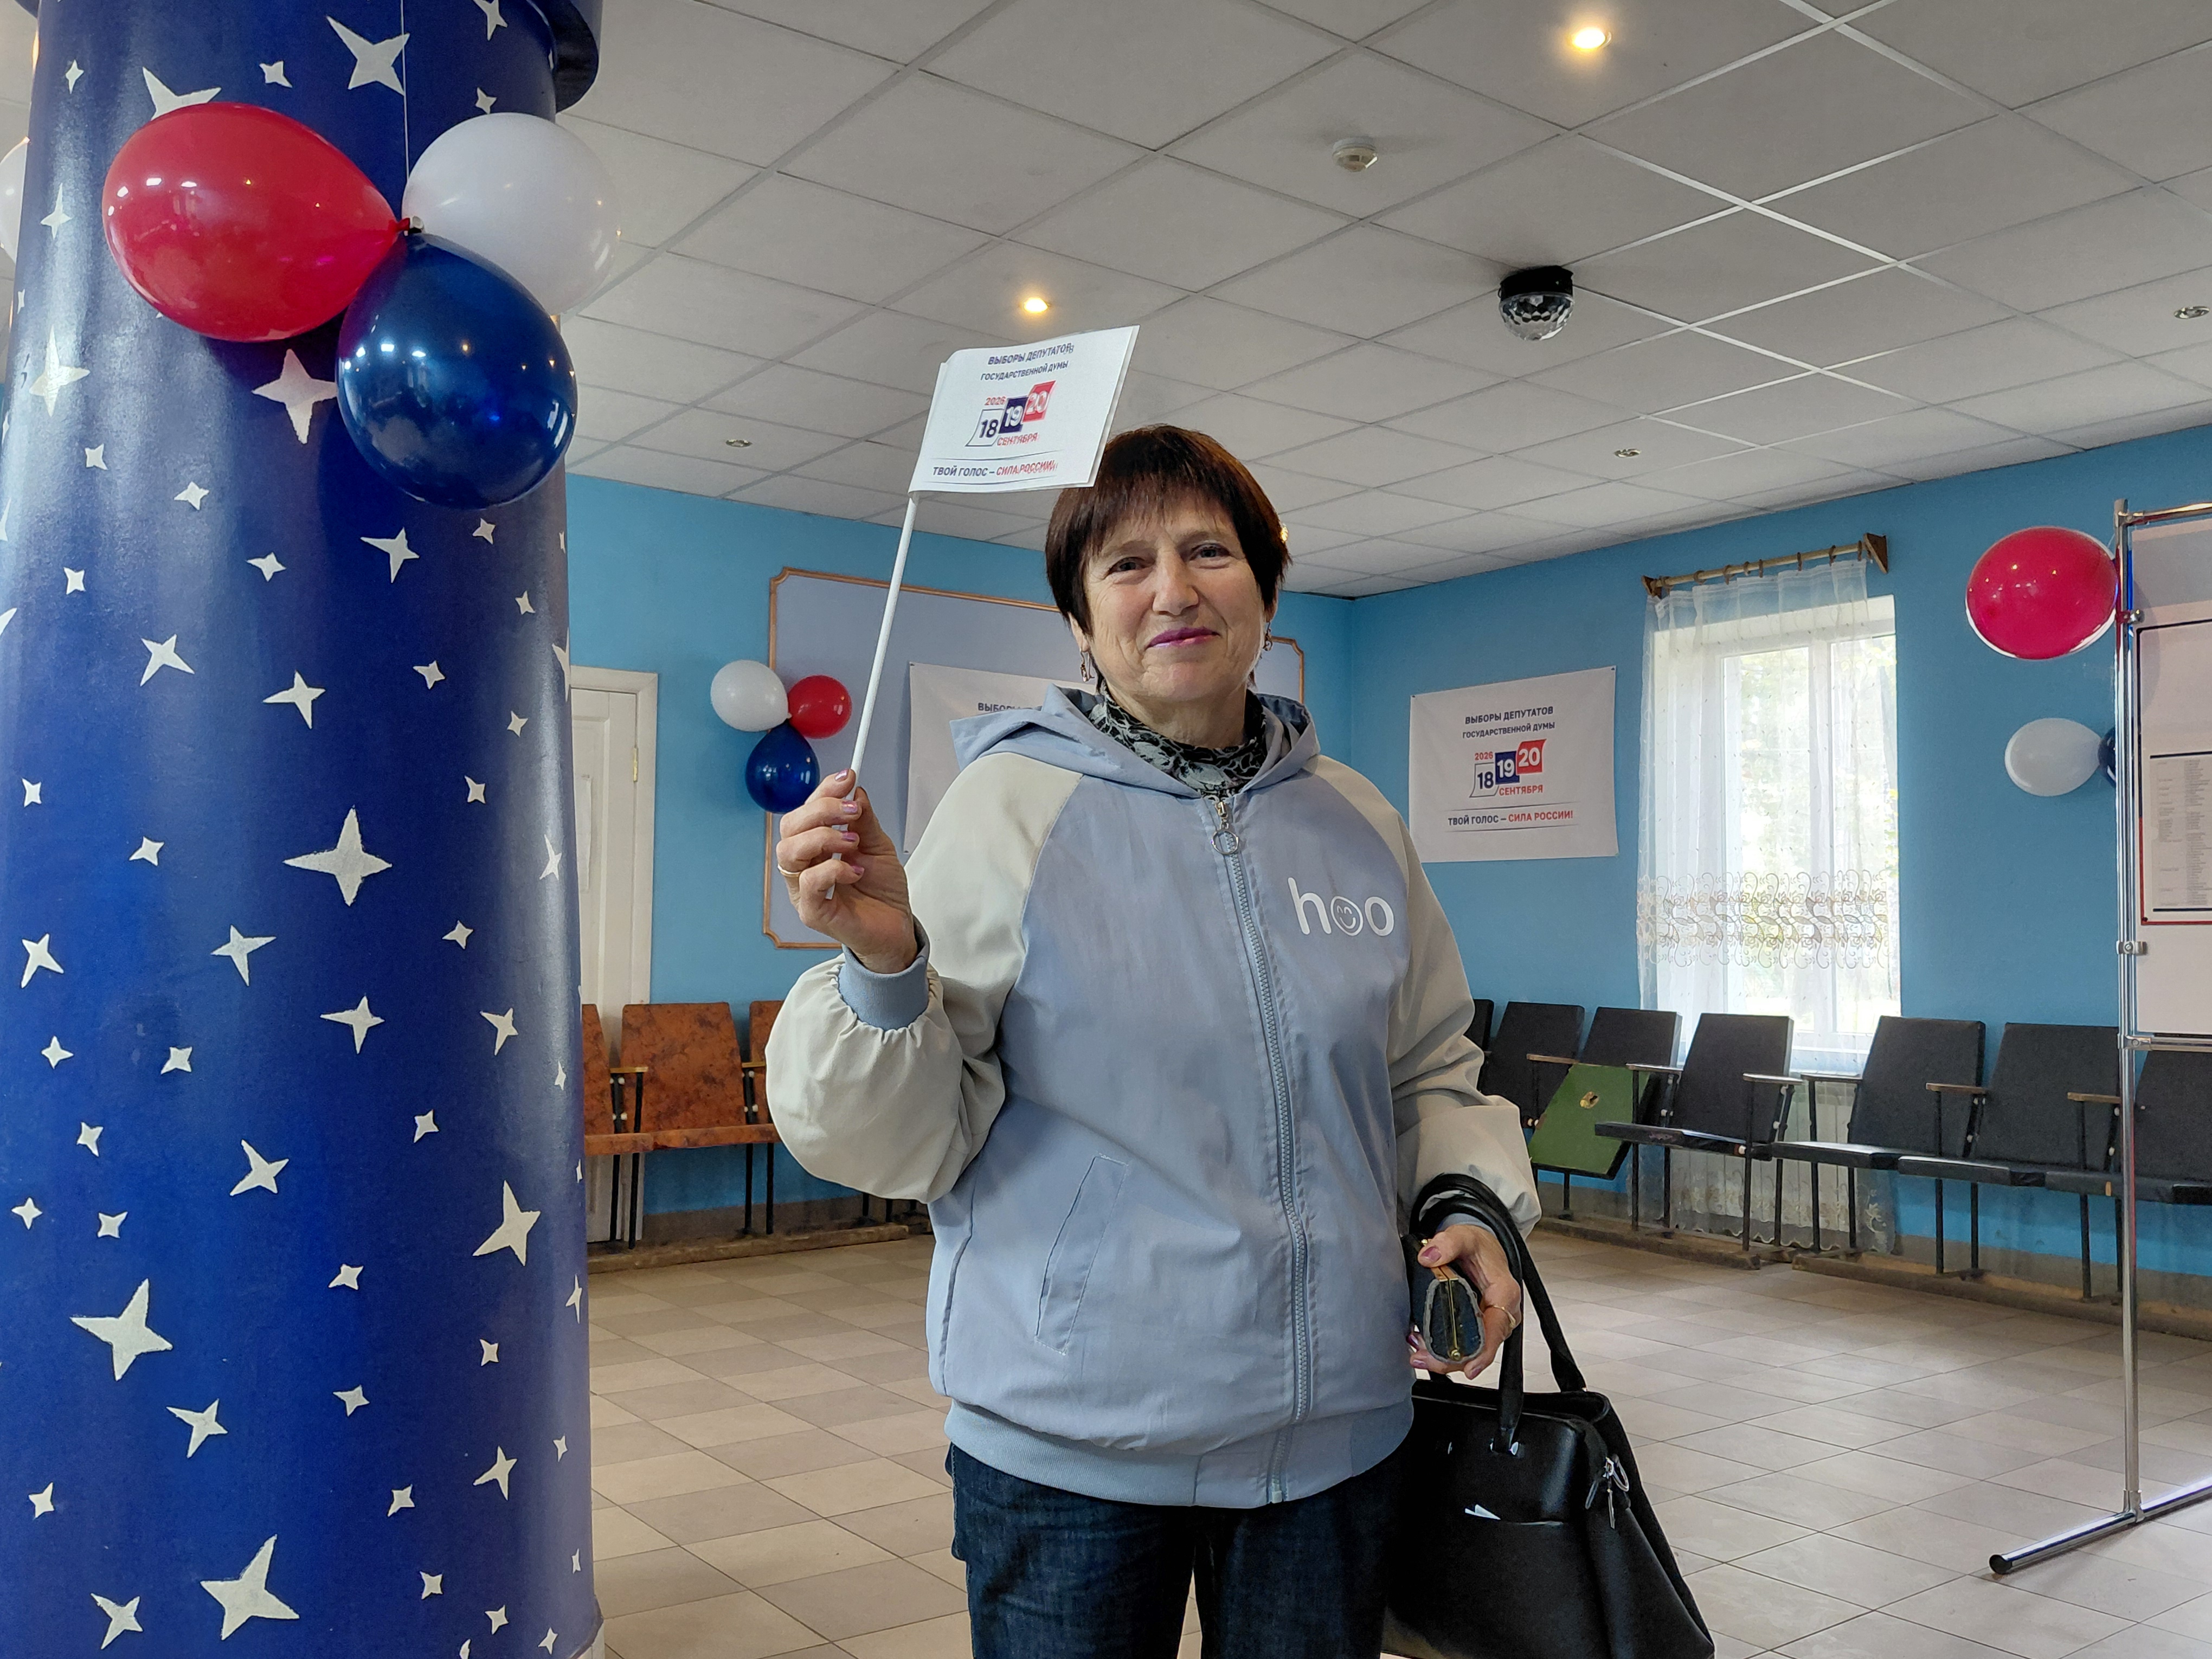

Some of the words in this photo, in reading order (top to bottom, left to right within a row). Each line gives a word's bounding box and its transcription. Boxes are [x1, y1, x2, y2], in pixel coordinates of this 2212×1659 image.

[988, 353, 1026, 365] ВЫБОРЫ
[1025, 343, 1073, 362] ДЕПУТАТОВ
[980, 363, 1049, 381] ГОСУДАРСТВЕННОЙ
[1047, 361, 1069, 373] ДУМЫ
[985, 396, 1006, 406] 2026
[979, 419, 999, 438] 18
[1005, 406, 1024, 427] 19
[1026, 391, 1049, 415] 20
[997, 432, 1038, 446] СЕНТЯБРЯ
[933, 465, 957, 476] ТВОЙ
[958, 467, 988, 477] ГОЛОС
[996, 465, 1019, 476] СИЛА
[1019, 460, 1057, 474] РОССИИ!
[1465, 713, 1501, 724] ВЫБОРЫ
[1503, 706, 1553, 722] ДЕПУТАТОВ
[1463, 723, 1531, 738] ГОСУДАРСТВЕННОЙ
[1533, 722, 1555, 732] ДУМЫ
[1475, 751, 1493, 760] 2026
[1477, 771, 1494, 789] 18
[1497, 759, 1515, 778] 19
[1518, 747, 1540, 767] 20
[1499, 785, 1543, 796] СЕНТЯБРЯ
[1448, 814, 1469, 825] ТВОЙ
[1471, 815, 1499, 824] ГОЛОС
[1508, 813, 1532, 822] СИЛА
[1534, 810, 1573, 821] РОССИИ!
